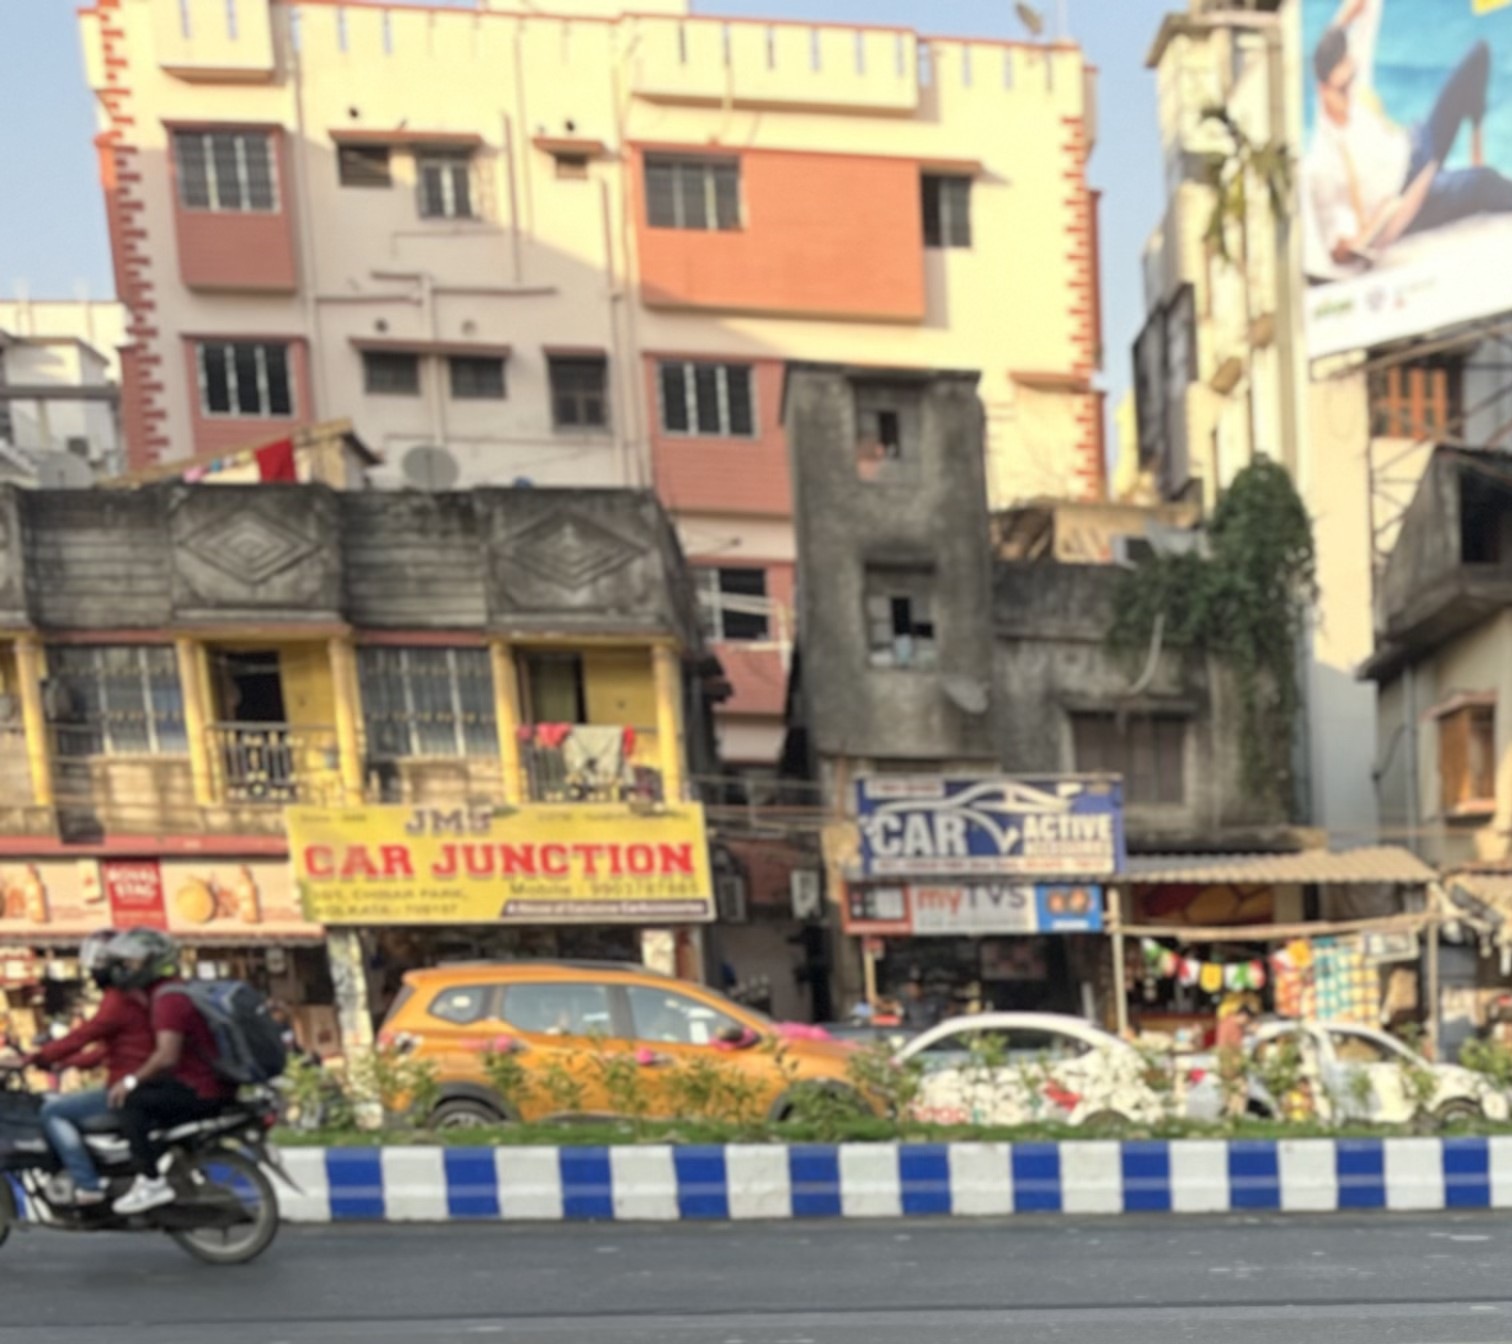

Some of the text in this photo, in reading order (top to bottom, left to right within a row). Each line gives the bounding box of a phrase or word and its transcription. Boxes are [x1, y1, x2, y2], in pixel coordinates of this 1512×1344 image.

[871, 814, 969, 856] CAR
[1023, 814, 1112, 842] ACTIVE
[304, 843, 694, 877] CAR JUNCTION
